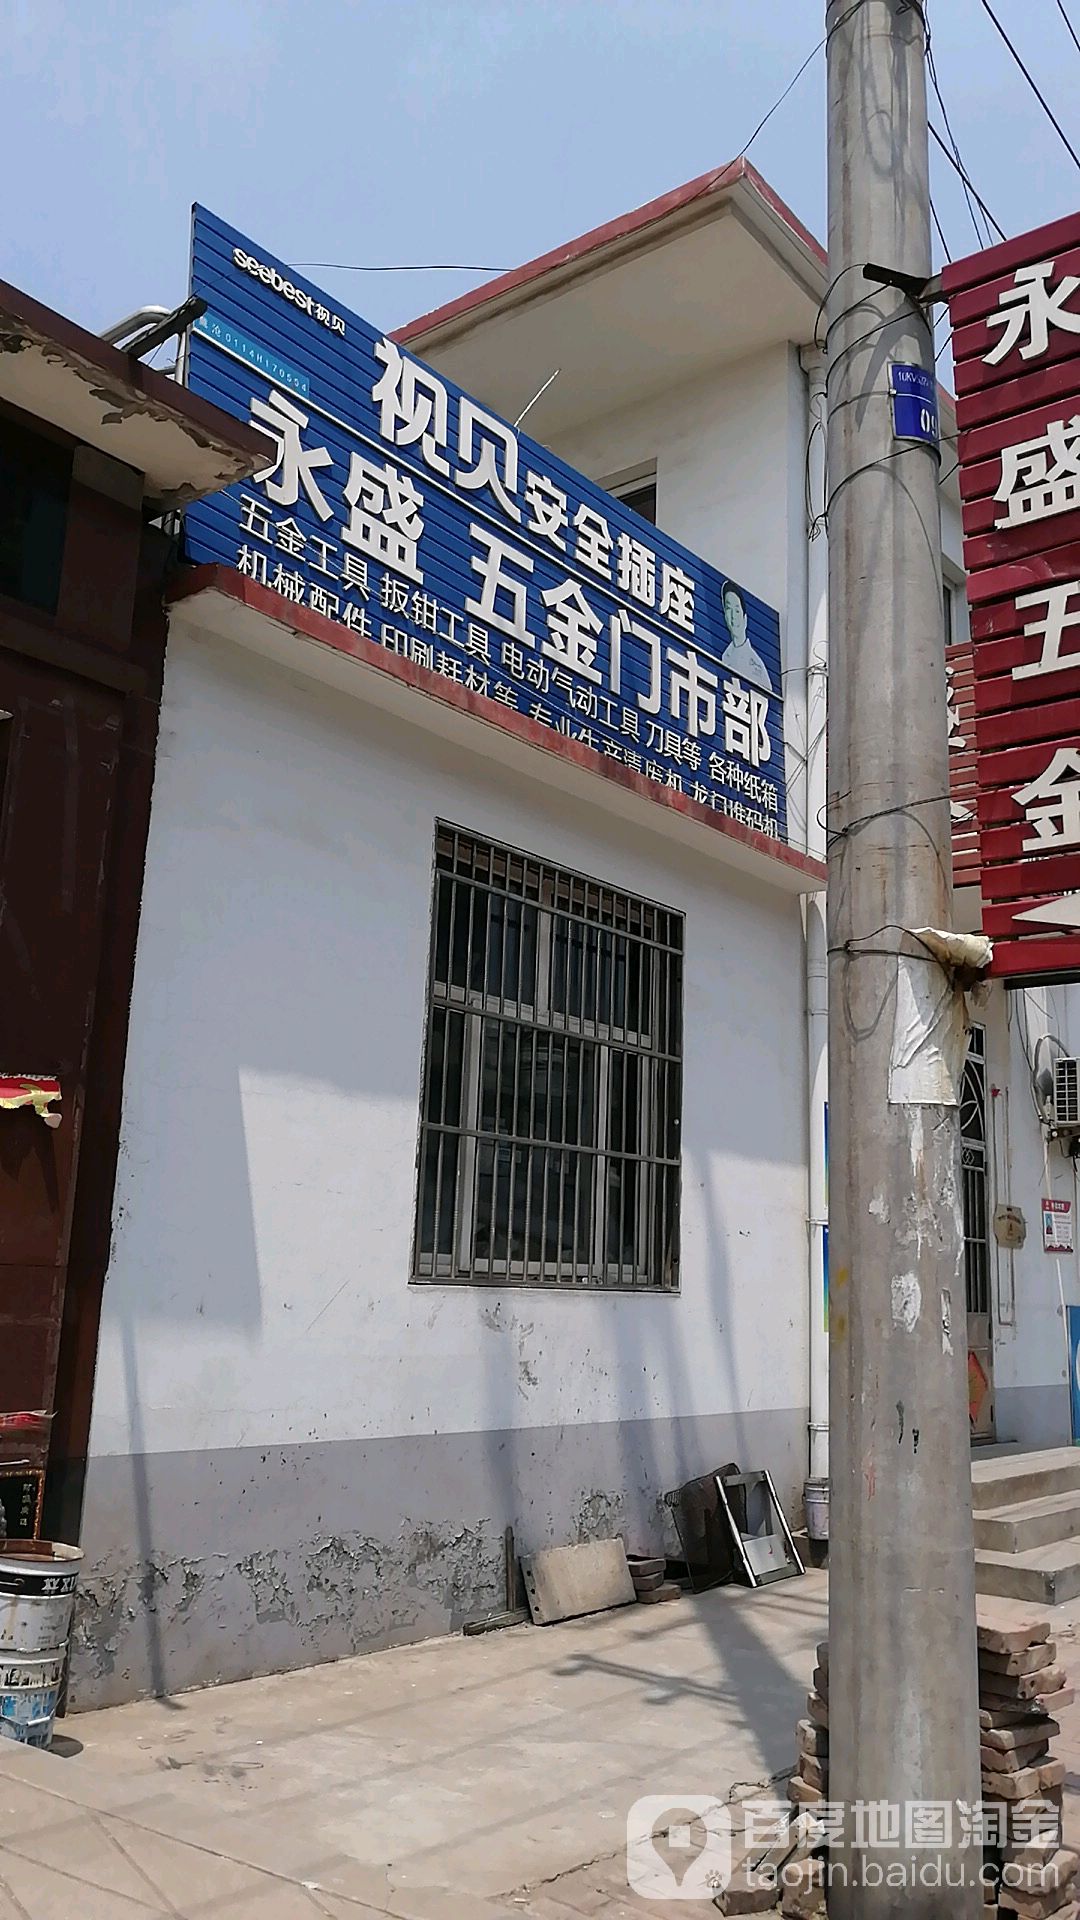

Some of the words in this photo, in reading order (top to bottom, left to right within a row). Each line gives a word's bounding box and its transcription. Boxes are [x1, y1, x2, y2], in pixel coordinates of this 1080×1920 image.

[239, 493, 371, 601] 五金工具
[502, 641, 641, 744] 电动气动工具
[645, 720, 702, 771] 刀具等
[709, 752, 779, 813] 各种纸箱
